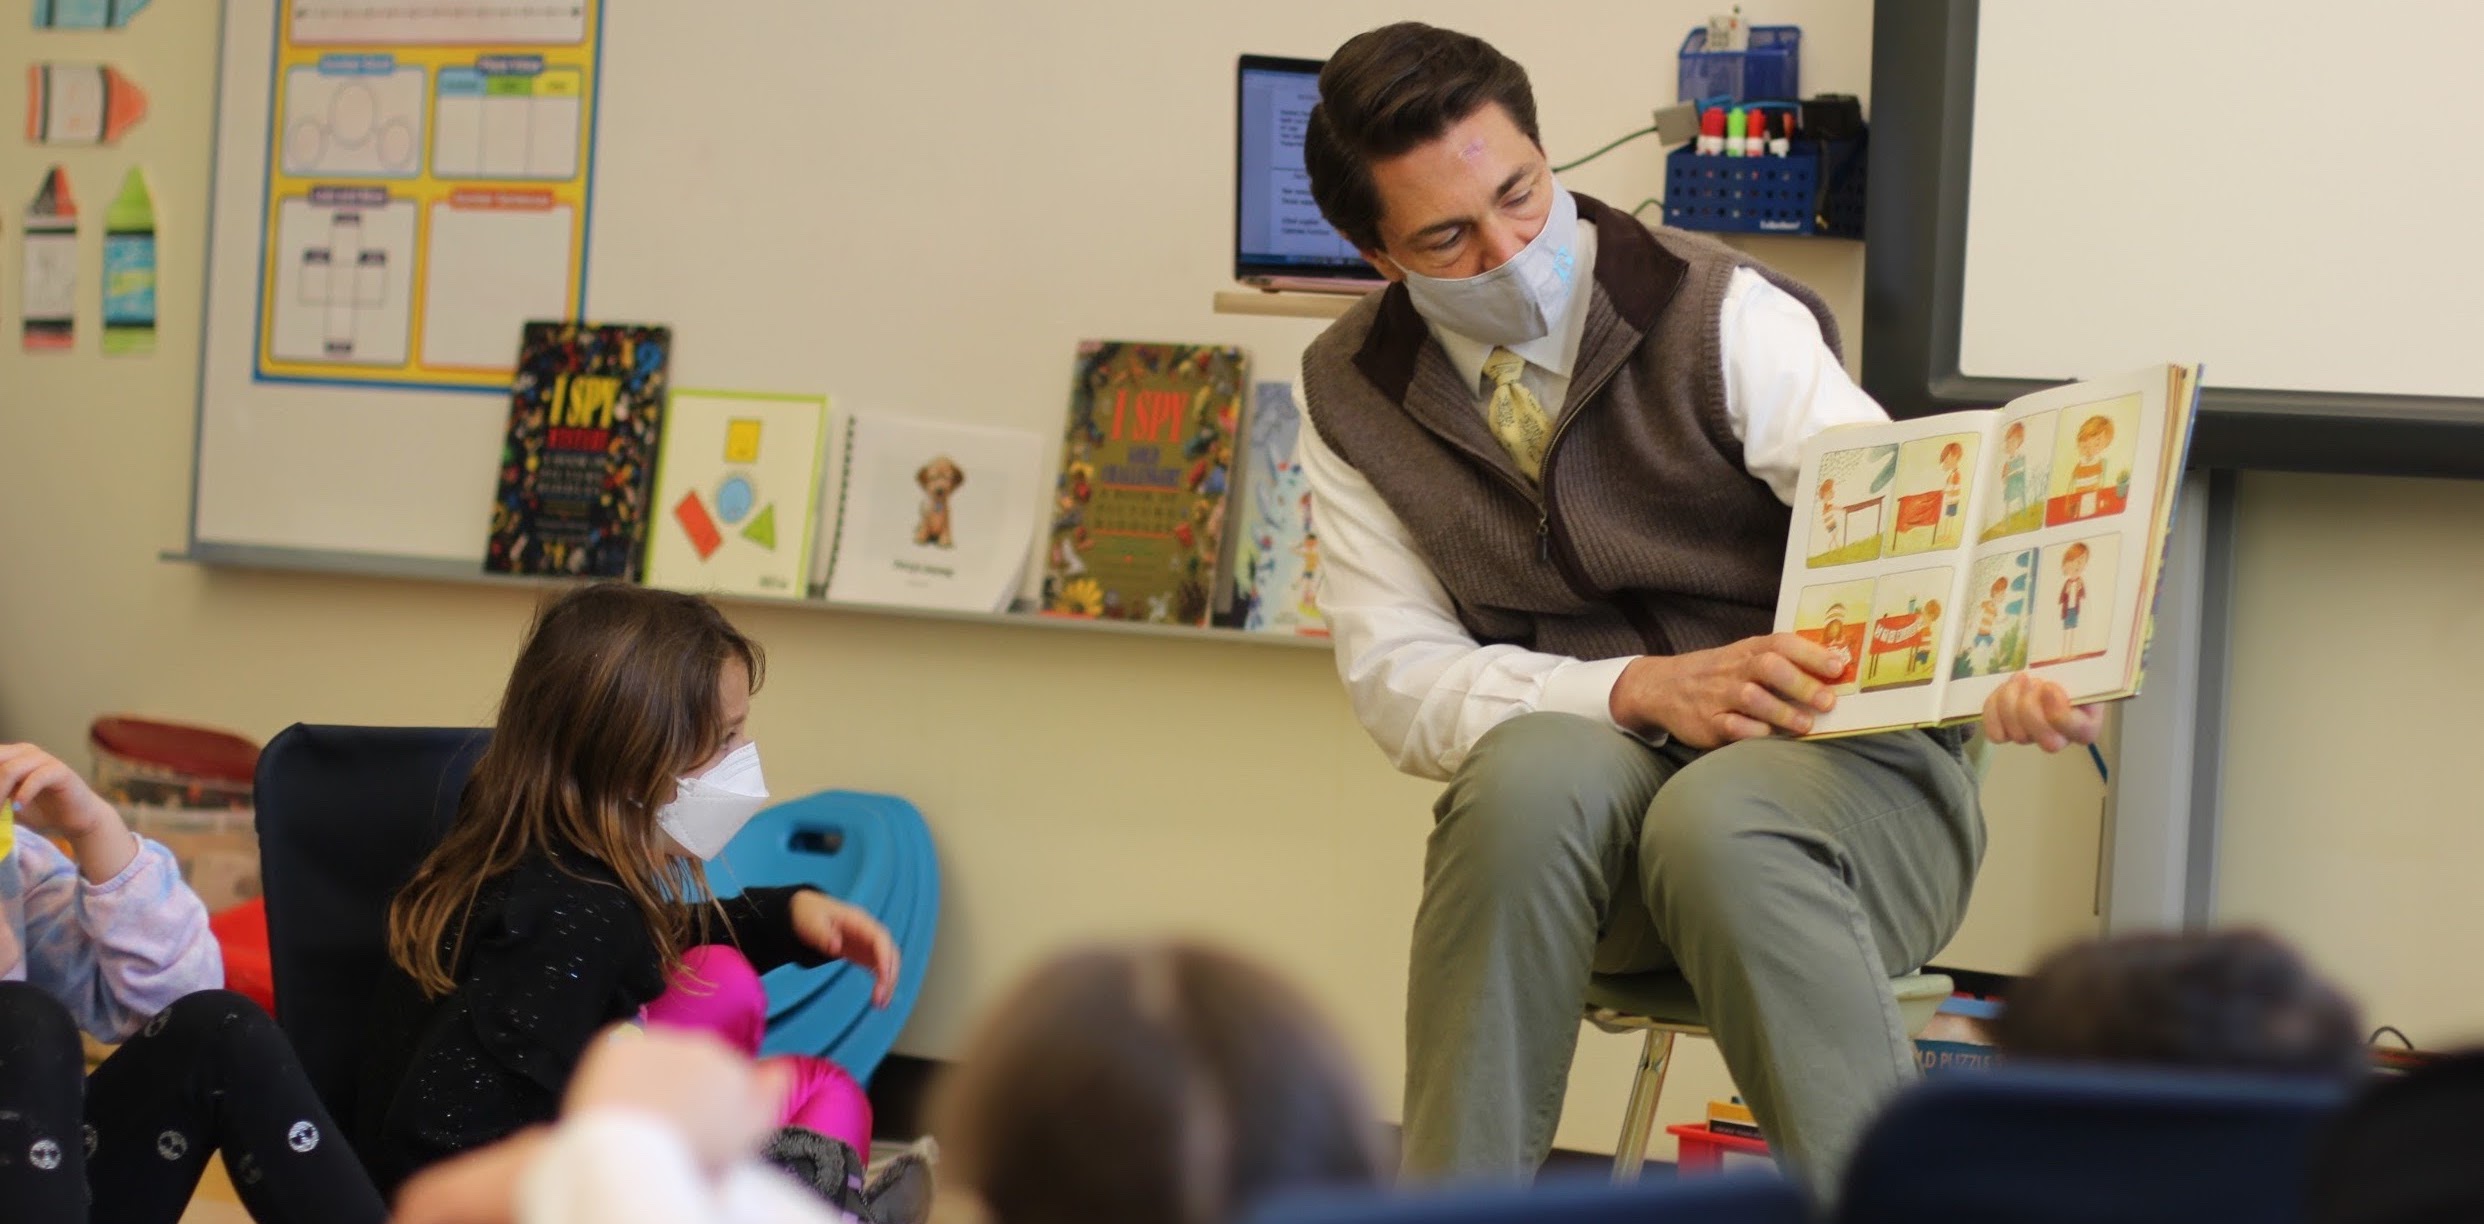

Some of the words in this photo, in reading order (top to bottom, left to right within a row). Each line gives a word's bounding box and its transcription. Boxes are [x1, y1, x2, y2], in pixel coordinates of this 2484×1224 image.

[549, 374, 568, 427] I
[566, 376, 620, 429] SPY
[1112, 388, 1128, 441] I
[1133, 389, 1189, 443] SPY
